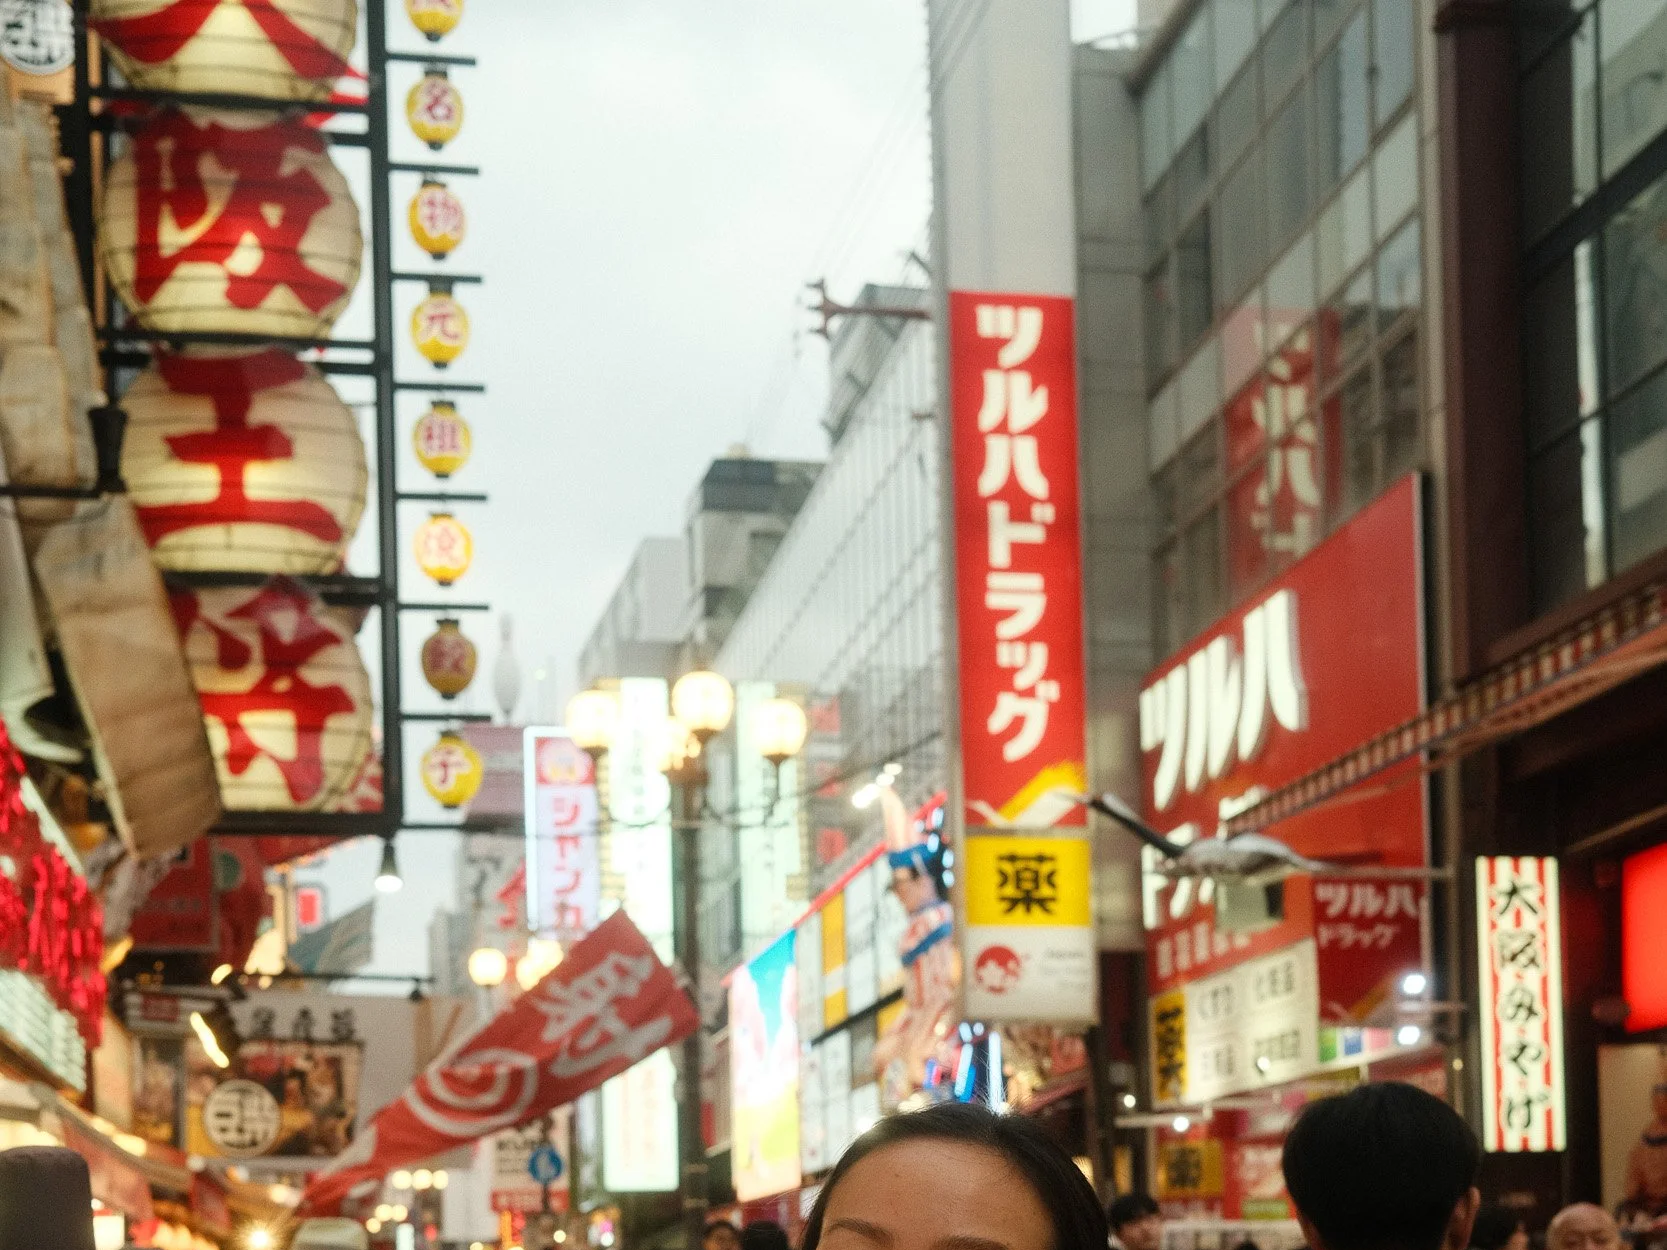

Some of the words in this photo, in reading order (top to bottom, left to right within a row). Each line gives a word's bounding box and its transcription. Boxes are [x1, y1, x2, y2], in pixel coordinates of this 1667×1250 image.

[973, 302, 1058, 762] ツルハドラッグ
[1139, 588, 1307, 812] ツルハ
[995, 851, 1059, 915] 薬
[1315, 881, 1421, 920] ツルハ
[1318, 921, 1400, 950] ドラッグ
[1495, 879, 1550, 1130] 大阪みやげ
